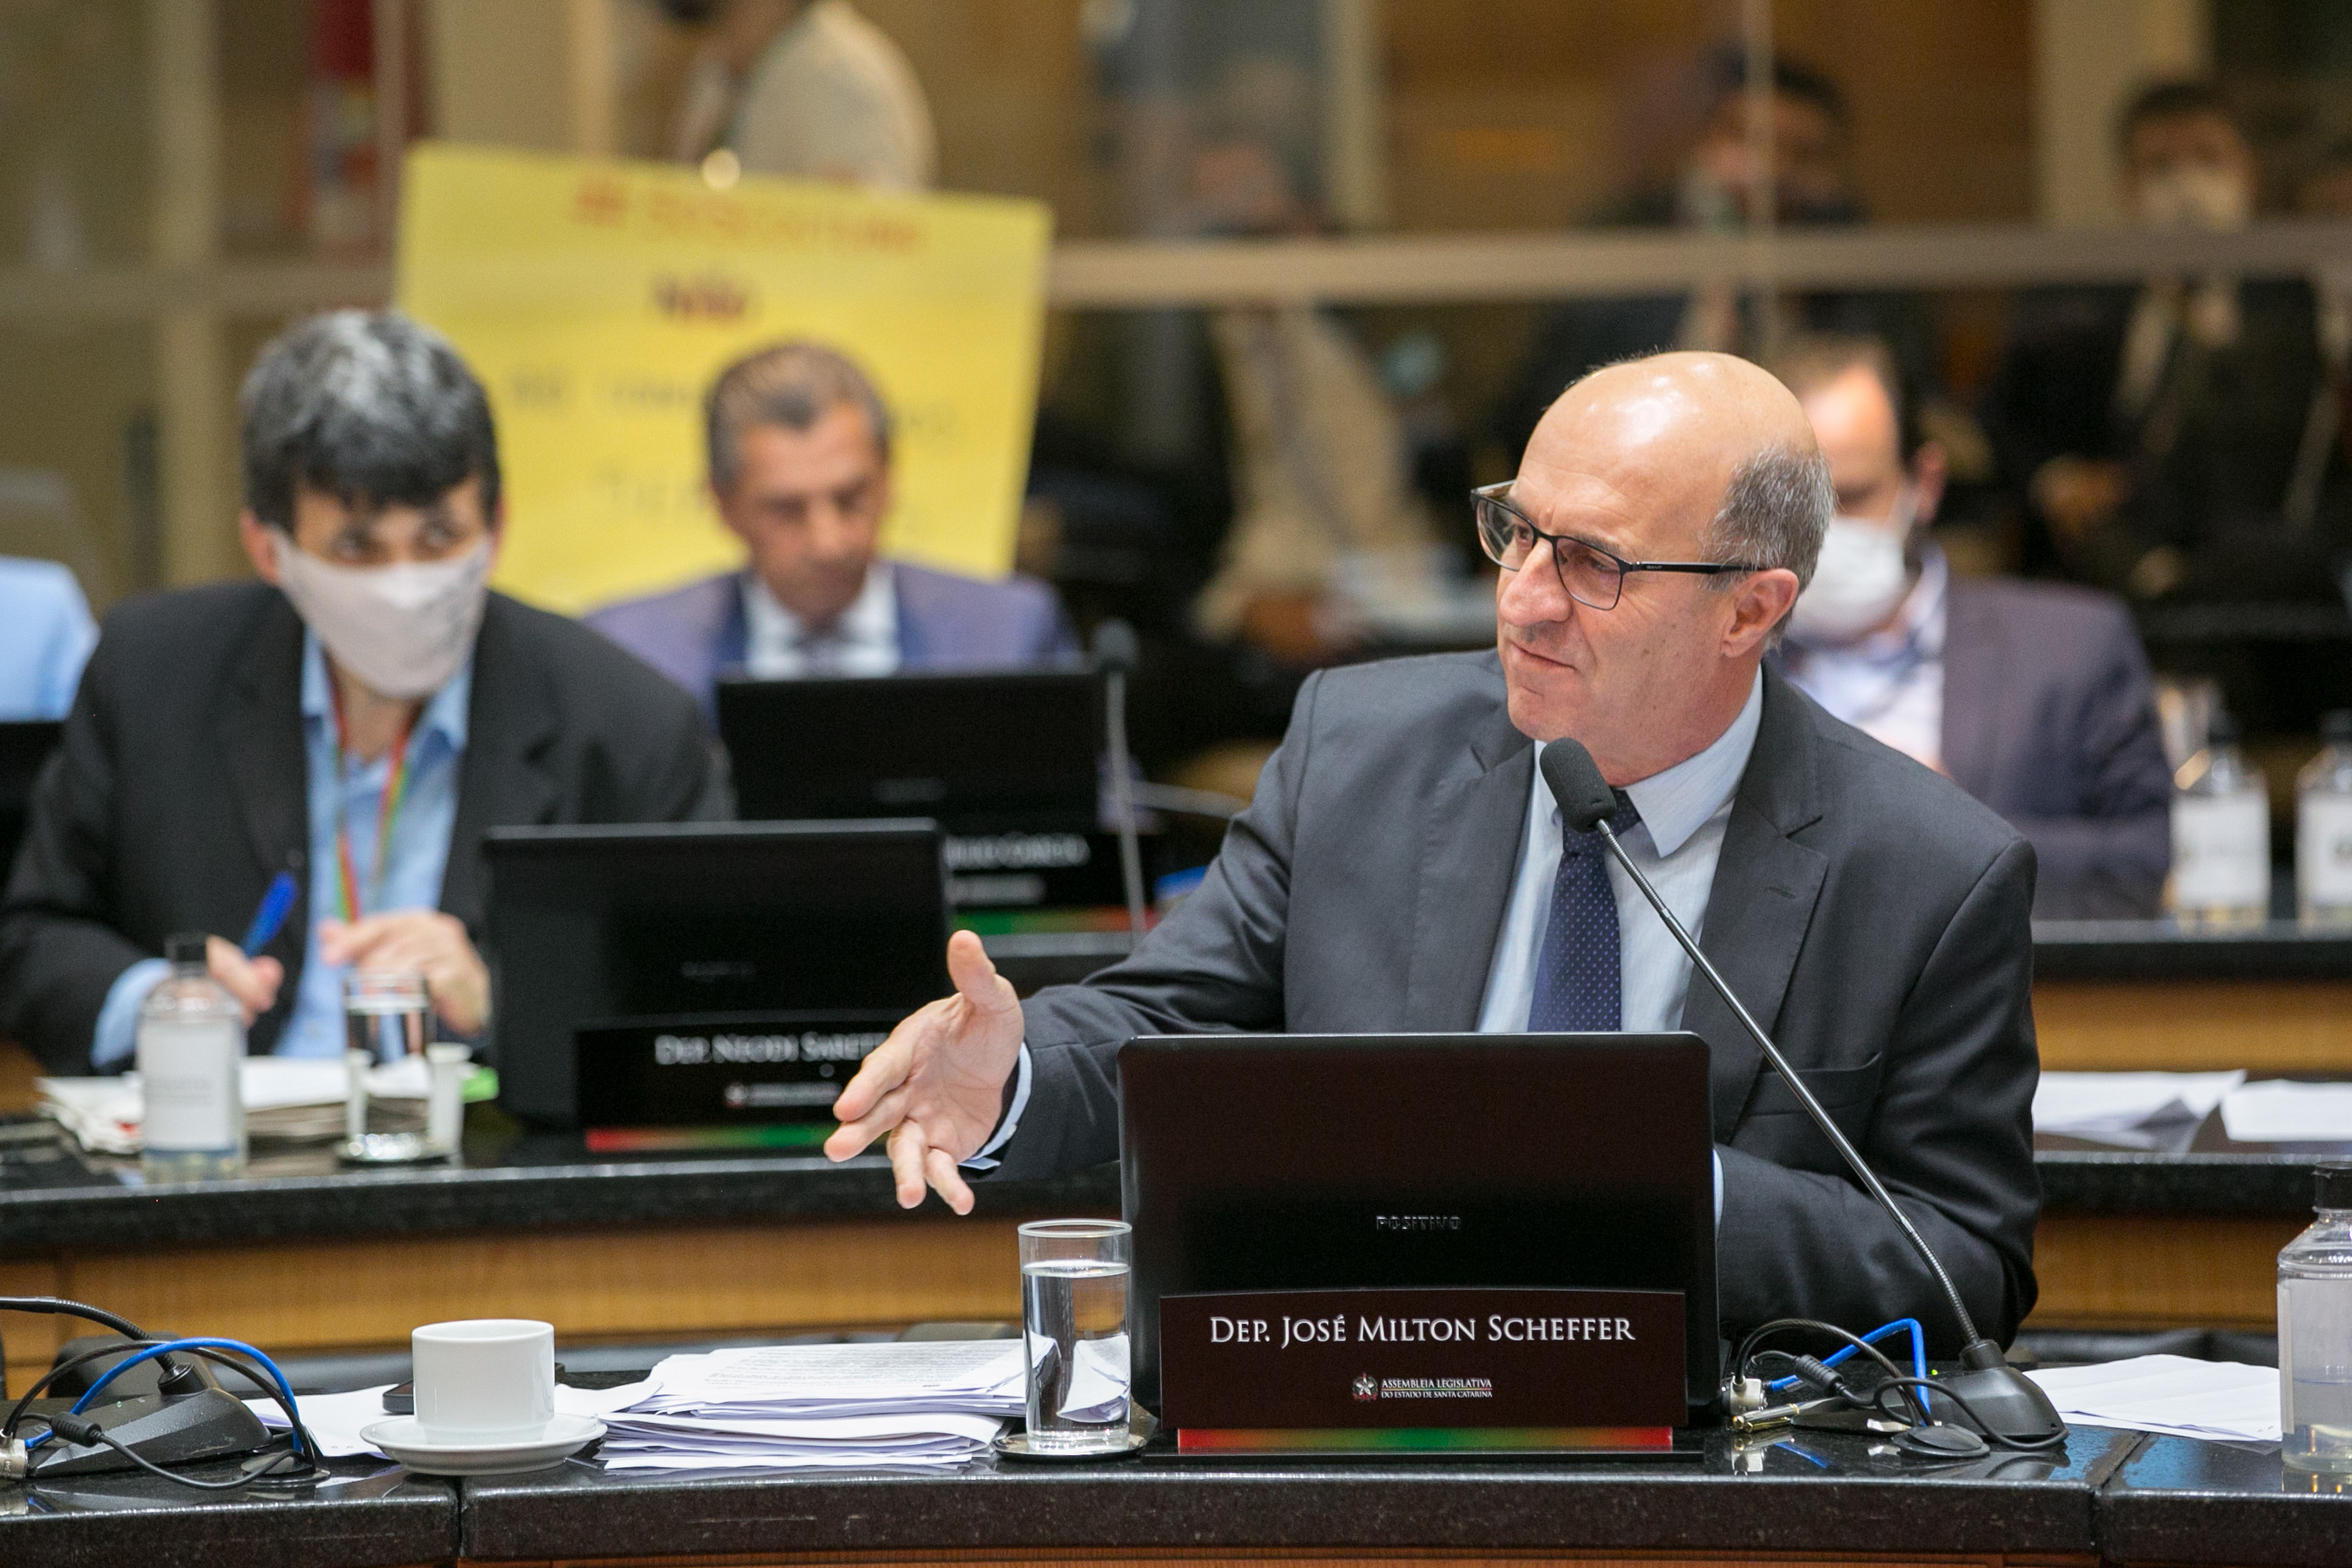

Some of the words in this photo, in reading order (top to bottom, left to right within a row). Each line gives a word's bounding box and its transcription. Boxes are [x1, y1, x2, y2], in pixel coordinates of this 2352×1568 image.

[1210, 1316, 1271, 1342] DEP.
[1281, 1314, 1347, 1349] JOSÉ
[1358, 1315, 1476, 1342] MILTON
[1488, 1314, 1636, 1342] SCHEFFER
[1381, 1378, 1435, 1388] ASSEMBLEIA
[1437, 1378, 1492, 1388] LEGISLATIVA
